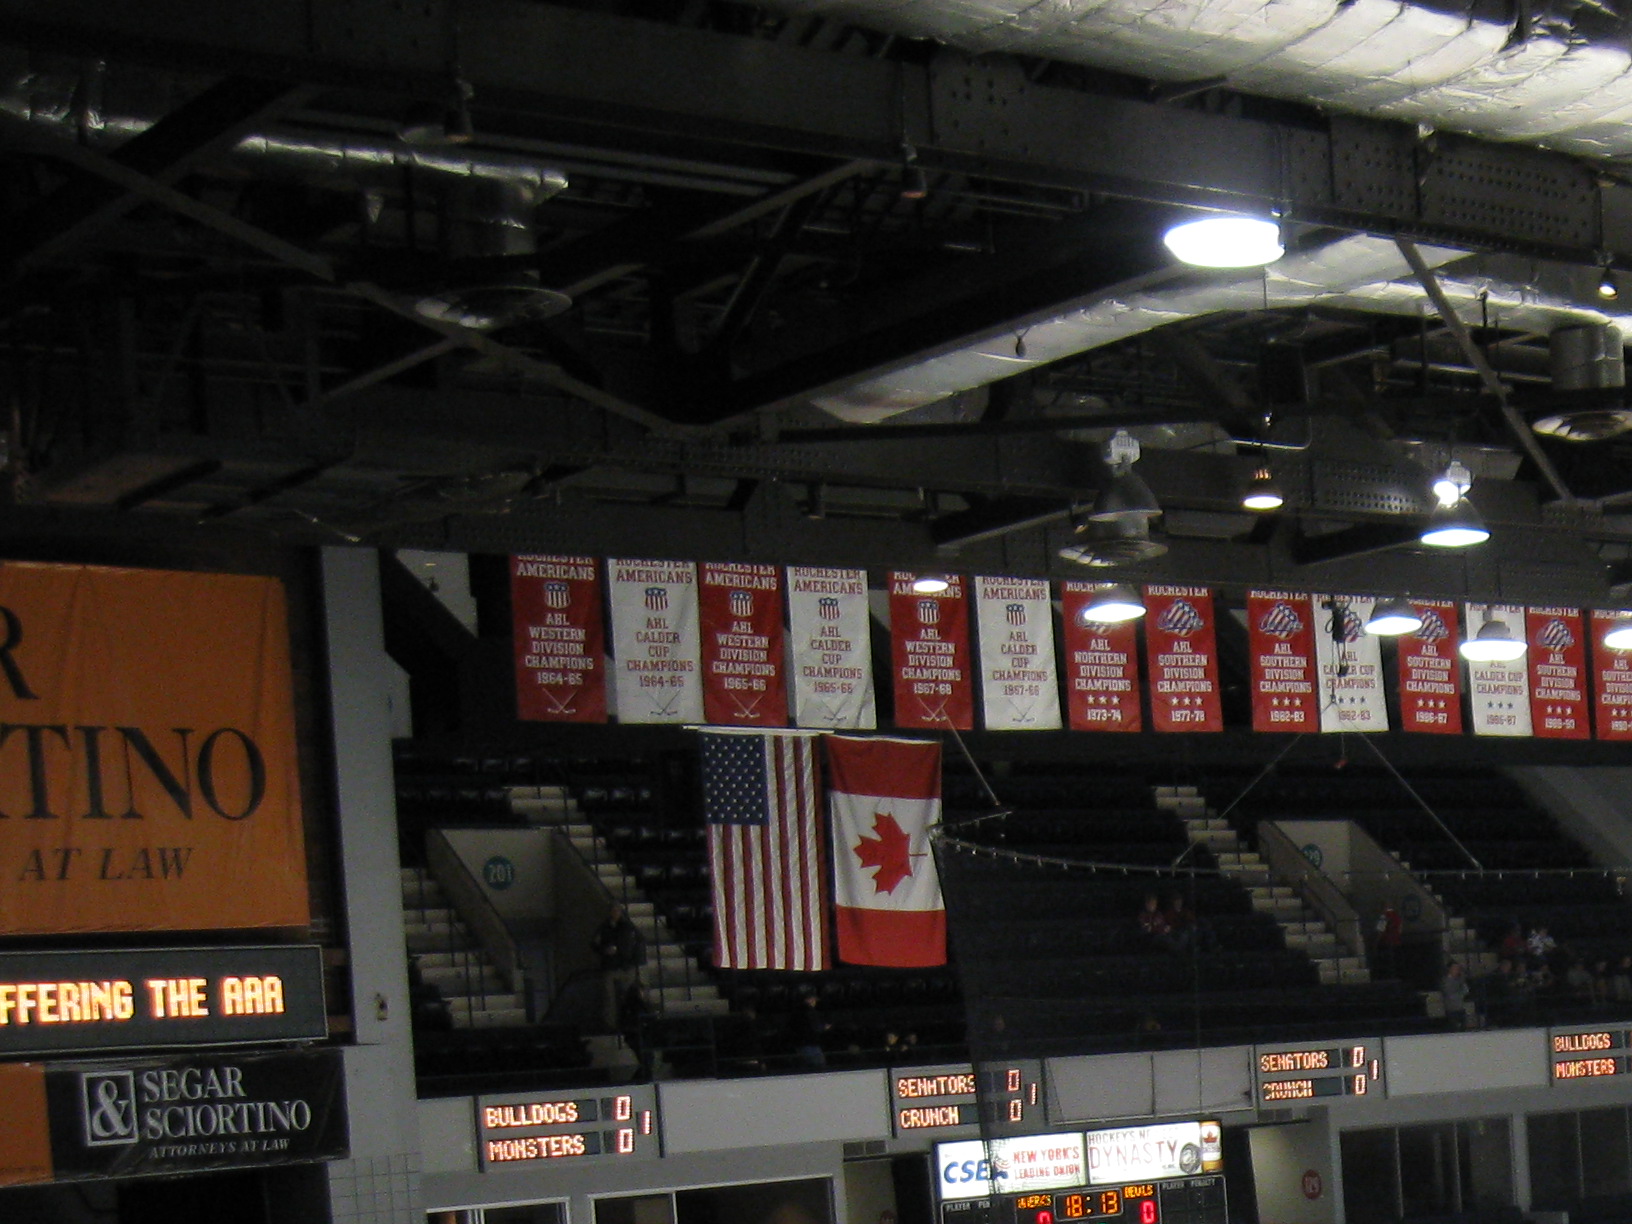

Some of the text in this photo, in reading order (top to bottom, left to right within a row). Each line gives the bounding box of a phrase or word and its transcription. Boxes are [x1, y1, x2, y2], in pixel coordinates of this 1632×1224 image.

[517, 563, 595, 581] AMERICANS
[617, 570, 692, 584] AMERICANS
[705, 572, 777, 589] AMERICANS
[794, 580, 863, 594] AMERICANS
[983, 588, 1047, 600] AMERICANS
[546, 613, 570, 625] AHL
[646, 617, 668, 629] AHL
[732, 621, 753, 633] AHL
[820, 626, 841, 638] AHL
[529, 627, 586, 641] WESTERN
[636, 631, 680, 643] CALDER
[920, 629, 941, 640] AHL
[1009, 631, 1028, 642] AHL
[716, 634, 769, 648] WESTERN
[811, 639, 851, 651] CALDER
[905, 641, 955, 654] WESTERN
[1090, 639, 1111, 650] AHL
[1173, 642, 1192, 653] AHL
[532, 641, 584, 656] DIVISION
[648, 646, 669, 657] CUP
[720, 648, 767, 661] DIVISION
[1001, 644, 1037, 655] CALDER
[1274, 644, 1292, 654] AHL
[525, 656, 594, 670] CHAMPIONS
[822, 654, 842, 664] CUP
[909, 655, 953, 667] DIVISION
[1012, 658, 1030, 668] CUP
[1074, 652, 1127, 665] NORTHERN
[1158, 655, 1207, 666] SOUTHERN
[1260, 655, 1307, 668] SOUTHERN
[627, 660, 694, 671] CHAMPIONS
[713, 662, 775, 676] CHAMPIONS
[1080, 666, 1123, 677] DIVISION
[1359, 665, 1375, 676] CUP
[803, 666, 862, 679] CHAMPIONS
[902, 669, 961, 681] CHAMPIONS
[993, 671, 1048, 682] CHAMPIONS
[1164, 668, 1204, 679] DIVISION
[1266, 668, 1305, 680] DIVISION
[1075, 679, 1131, 691] CHAMPIONS
[1157, 681, 1212, 692] CHAMPIONS
[1260, 681, 1312, 693] CHAMPIONS
[1406, 681, 1455, 694] CHAMPIONS
[19, 848, 192, 880] AT LAW
[147, 978, 209, 1018] THE
[221, 976, 285, 1015] AAA
[1554, 1033, 1611, 1052] BULLDOGS
[1261, 1051, 1328, 1072] SENATORS
[1556, 1059, 1615, 1078] MONSTERS
[142, 1066, 246, 1102] SEGAR
[899, 1074, 976, 1097] SENATORS
[145, 1100, 312, 1140] SCIORTINO
[485, 1102, 579, 1128] BULLDOGS
[900, 1106, 959, 1128] CRUNCH
[1088, 1131, 1135, 1145] HOCKEY'S
[150, 1139, 290, 1158] ATTORNEYS AT LAW
[488, 1135, 585, 1162] MONSTERS
[1089, 1140, 1178, 1169] DYNASTY
[1013, 1147, 1079, 1164] NEW YORK'S
[1014, 1164, 1080, 1179] LEADING UNION
[1124, 1185, 1153, 1198] DEVILS
